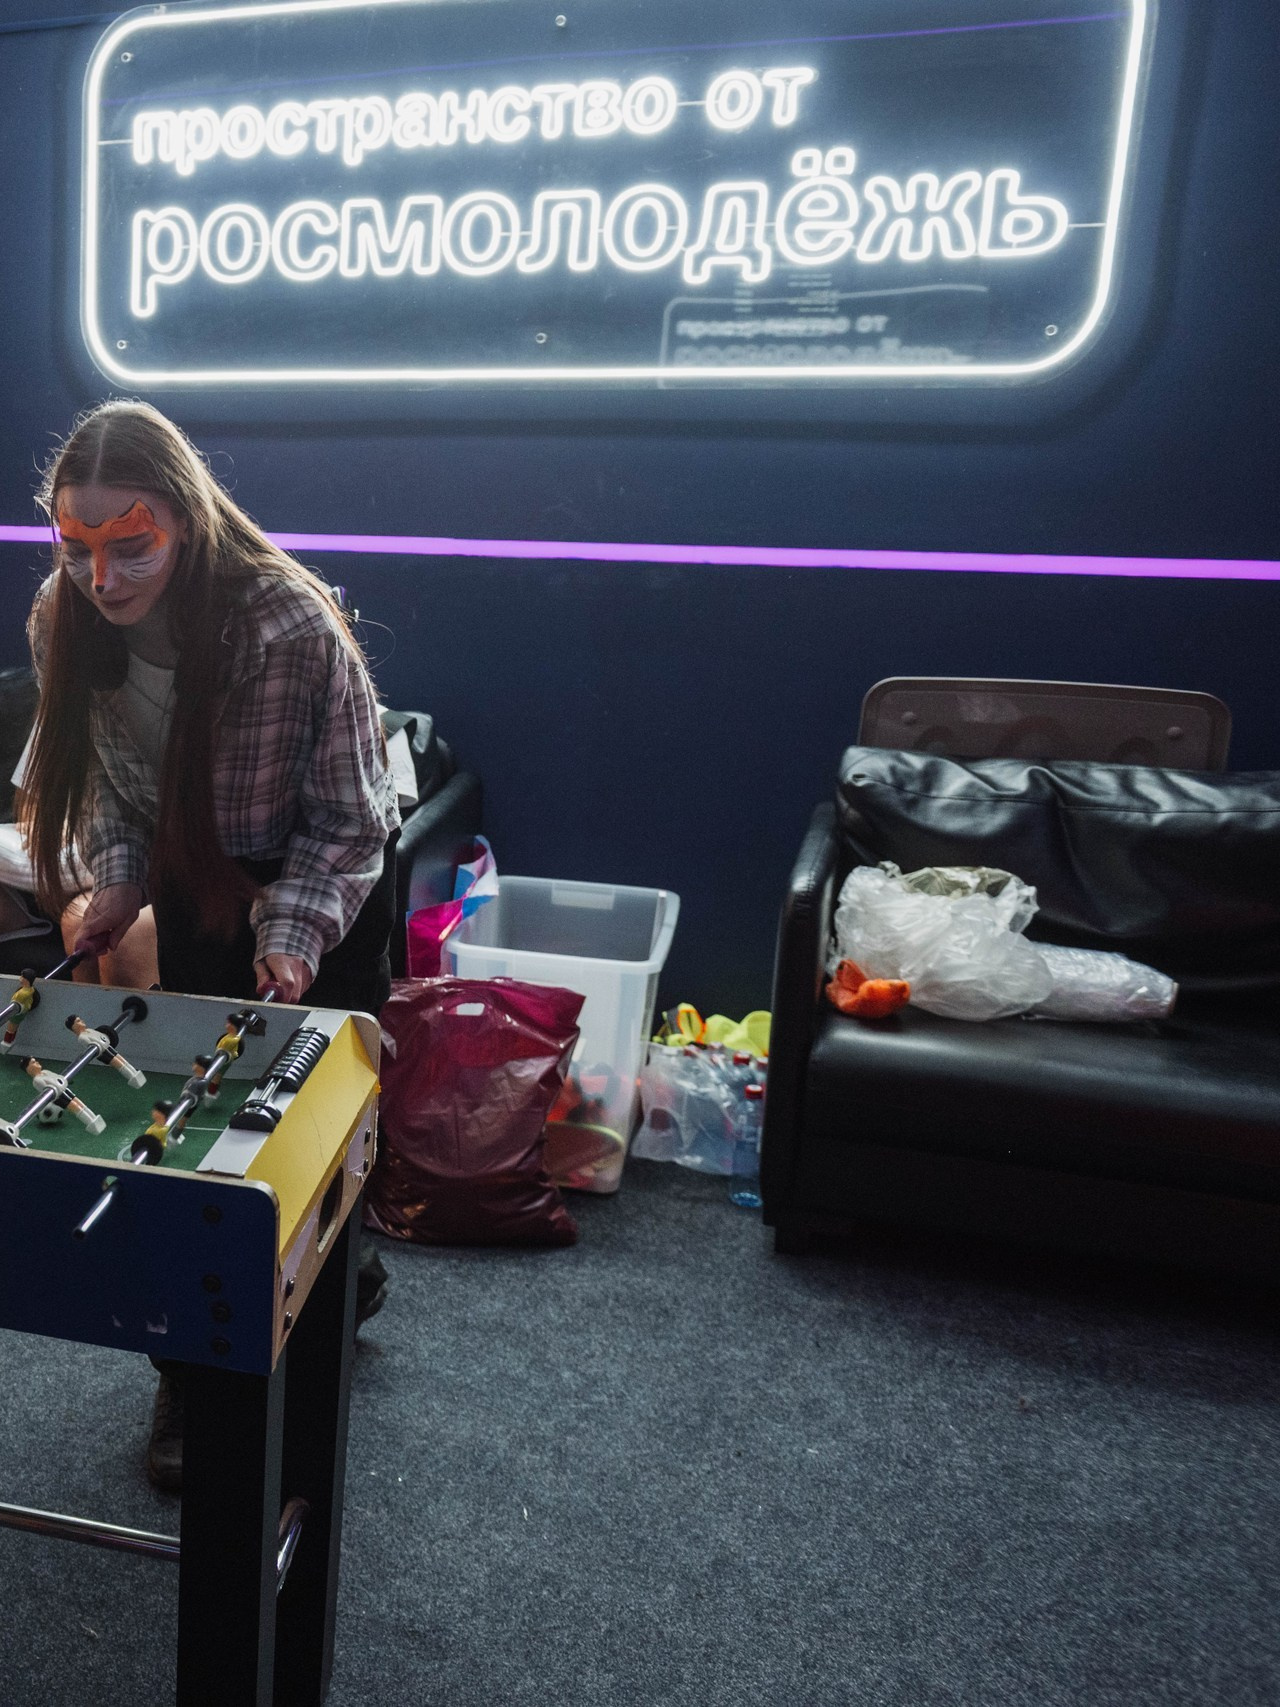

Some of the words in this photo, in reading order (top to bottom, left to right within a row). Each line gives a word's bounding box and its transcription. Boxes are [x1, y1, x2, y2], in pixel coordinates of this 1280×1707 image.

[131, 76, 678, 176] пространство
[704, 66, 815, 130] от
[130, 146, 1070, 318] росмолодёжь
